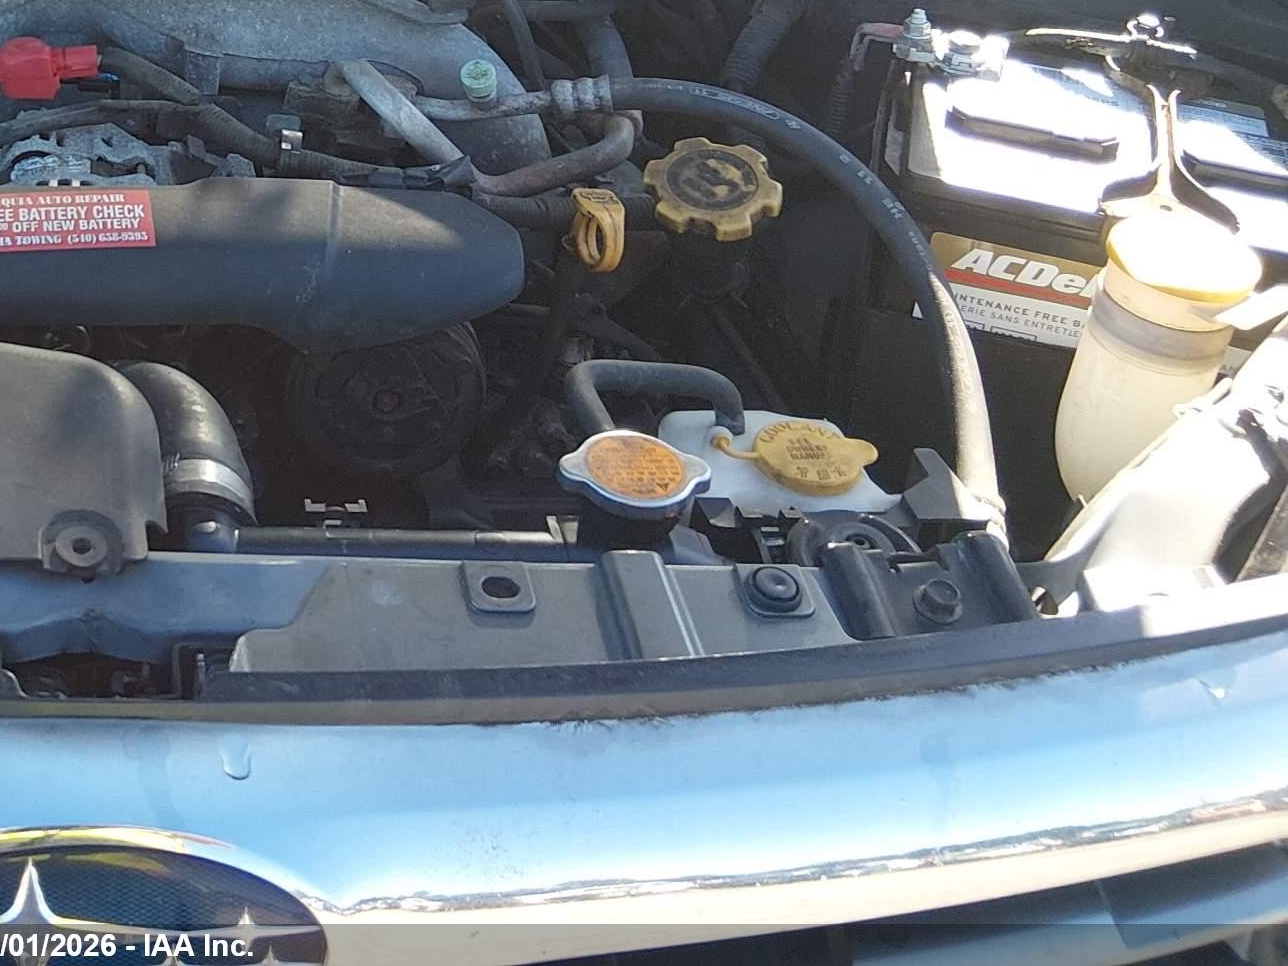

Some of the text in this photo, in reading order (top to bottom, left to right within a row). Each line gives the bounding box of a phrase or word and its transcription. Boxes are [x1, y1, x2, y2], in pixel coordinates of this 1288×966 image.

[37, 195, 72, 204] AUTO
[75, 193, 125, 203] REPAIR
[18, 206, 88, 221] BATTERY
[93, 204, 145, 219] CHECK
[12, 220, 39, 233] OFF
[43, 219, 77, 232] NEW
[79, 217, 140, 231] BATTERY
[14, 234, 62, 246] TOWING
[961, 305, 1079, 338] ERIE SANS ENTRETIE
[1034, 310, 1068, 325] FREE
